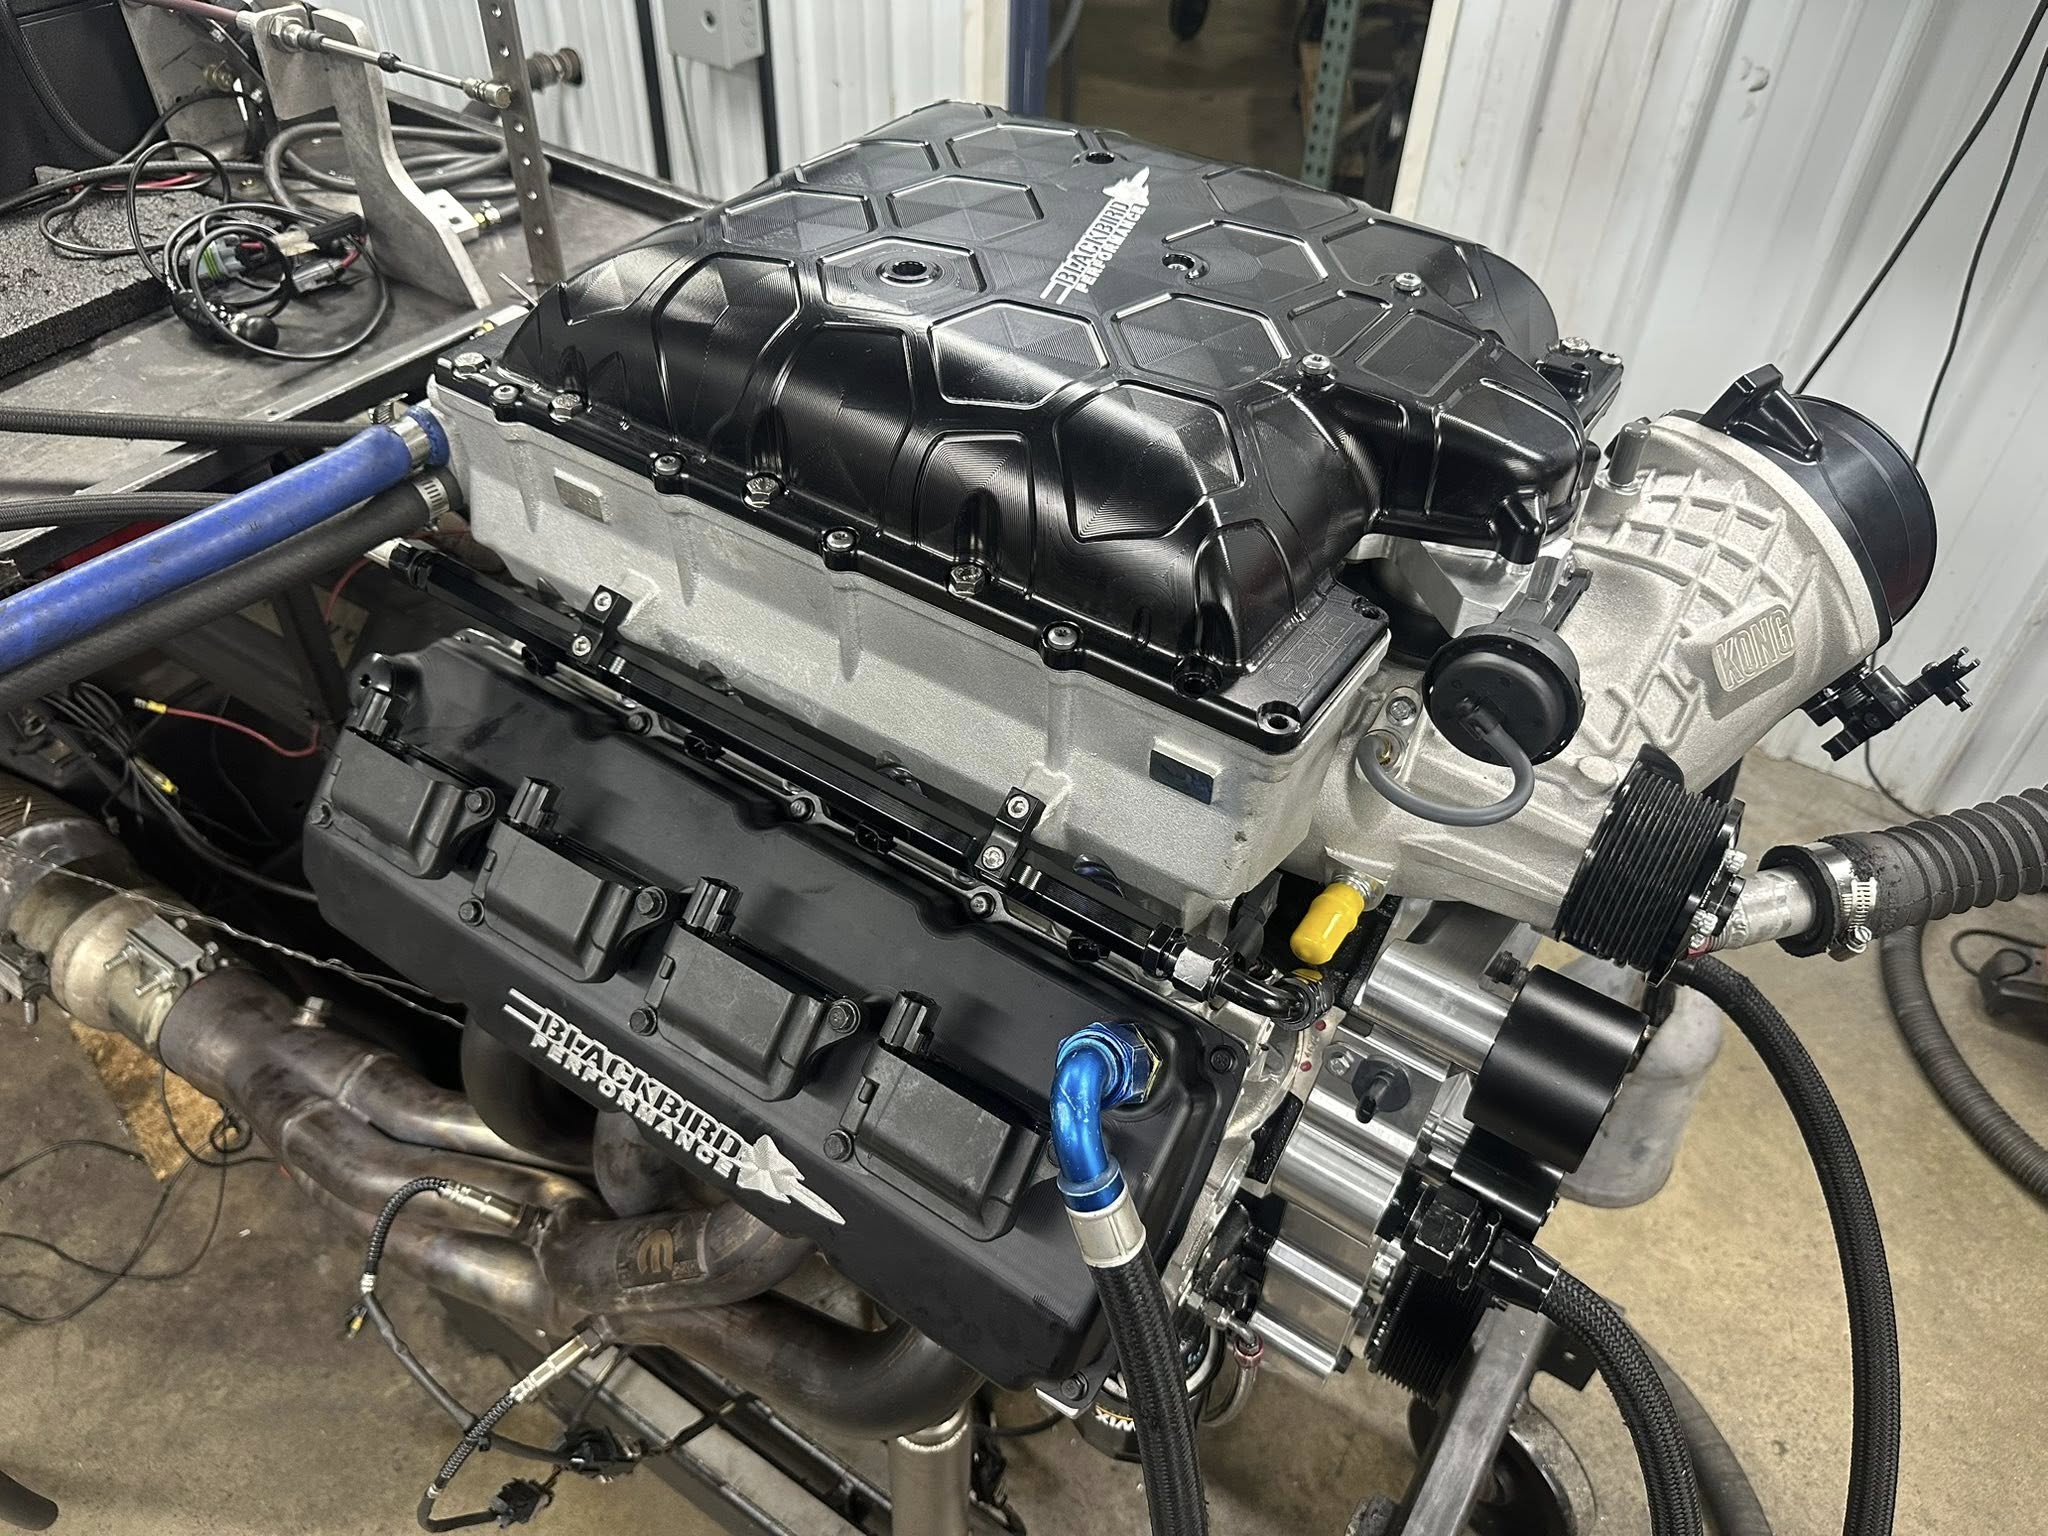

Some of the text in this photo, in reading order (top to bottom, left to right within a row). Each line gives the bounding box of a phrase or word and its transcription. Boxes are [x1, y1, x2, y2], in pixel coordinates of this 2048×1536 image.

[1051, 198, 1130, 288] BLACKBIRD
[1073, 201, 1149, 294] PERFORMANCE
[1715, 608, 1794, 690] KONG
[529, 1034, 734, 1179] PERFORMANCE
[537, 1007, 749, 1165] BLACKBIRD
[1094, 1405, 1137, 1432] WIX
